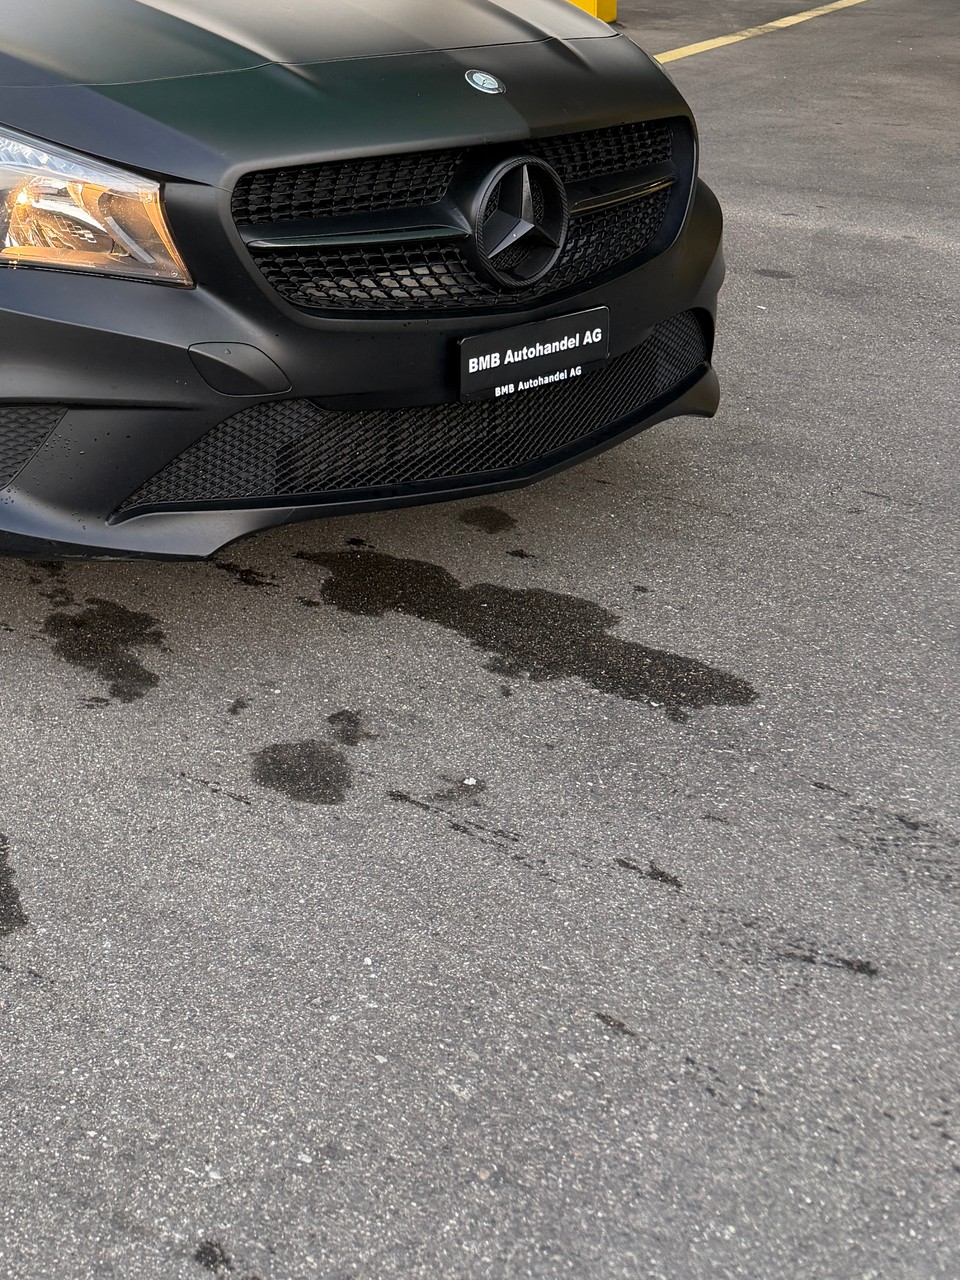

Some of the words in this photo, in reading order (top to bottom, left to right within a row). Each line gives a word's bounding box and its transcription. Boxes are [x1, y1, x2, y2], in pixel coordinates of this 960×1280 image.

[468, 352, 501, 374] BMB
[503, 333, 580, 365] Autohandel
[582, 328, 602, 346] AG
[494, 383, 515, 397] BMB
[517, 369, 568, 392] Autohandel
[569, 365, 582, 378] AG
